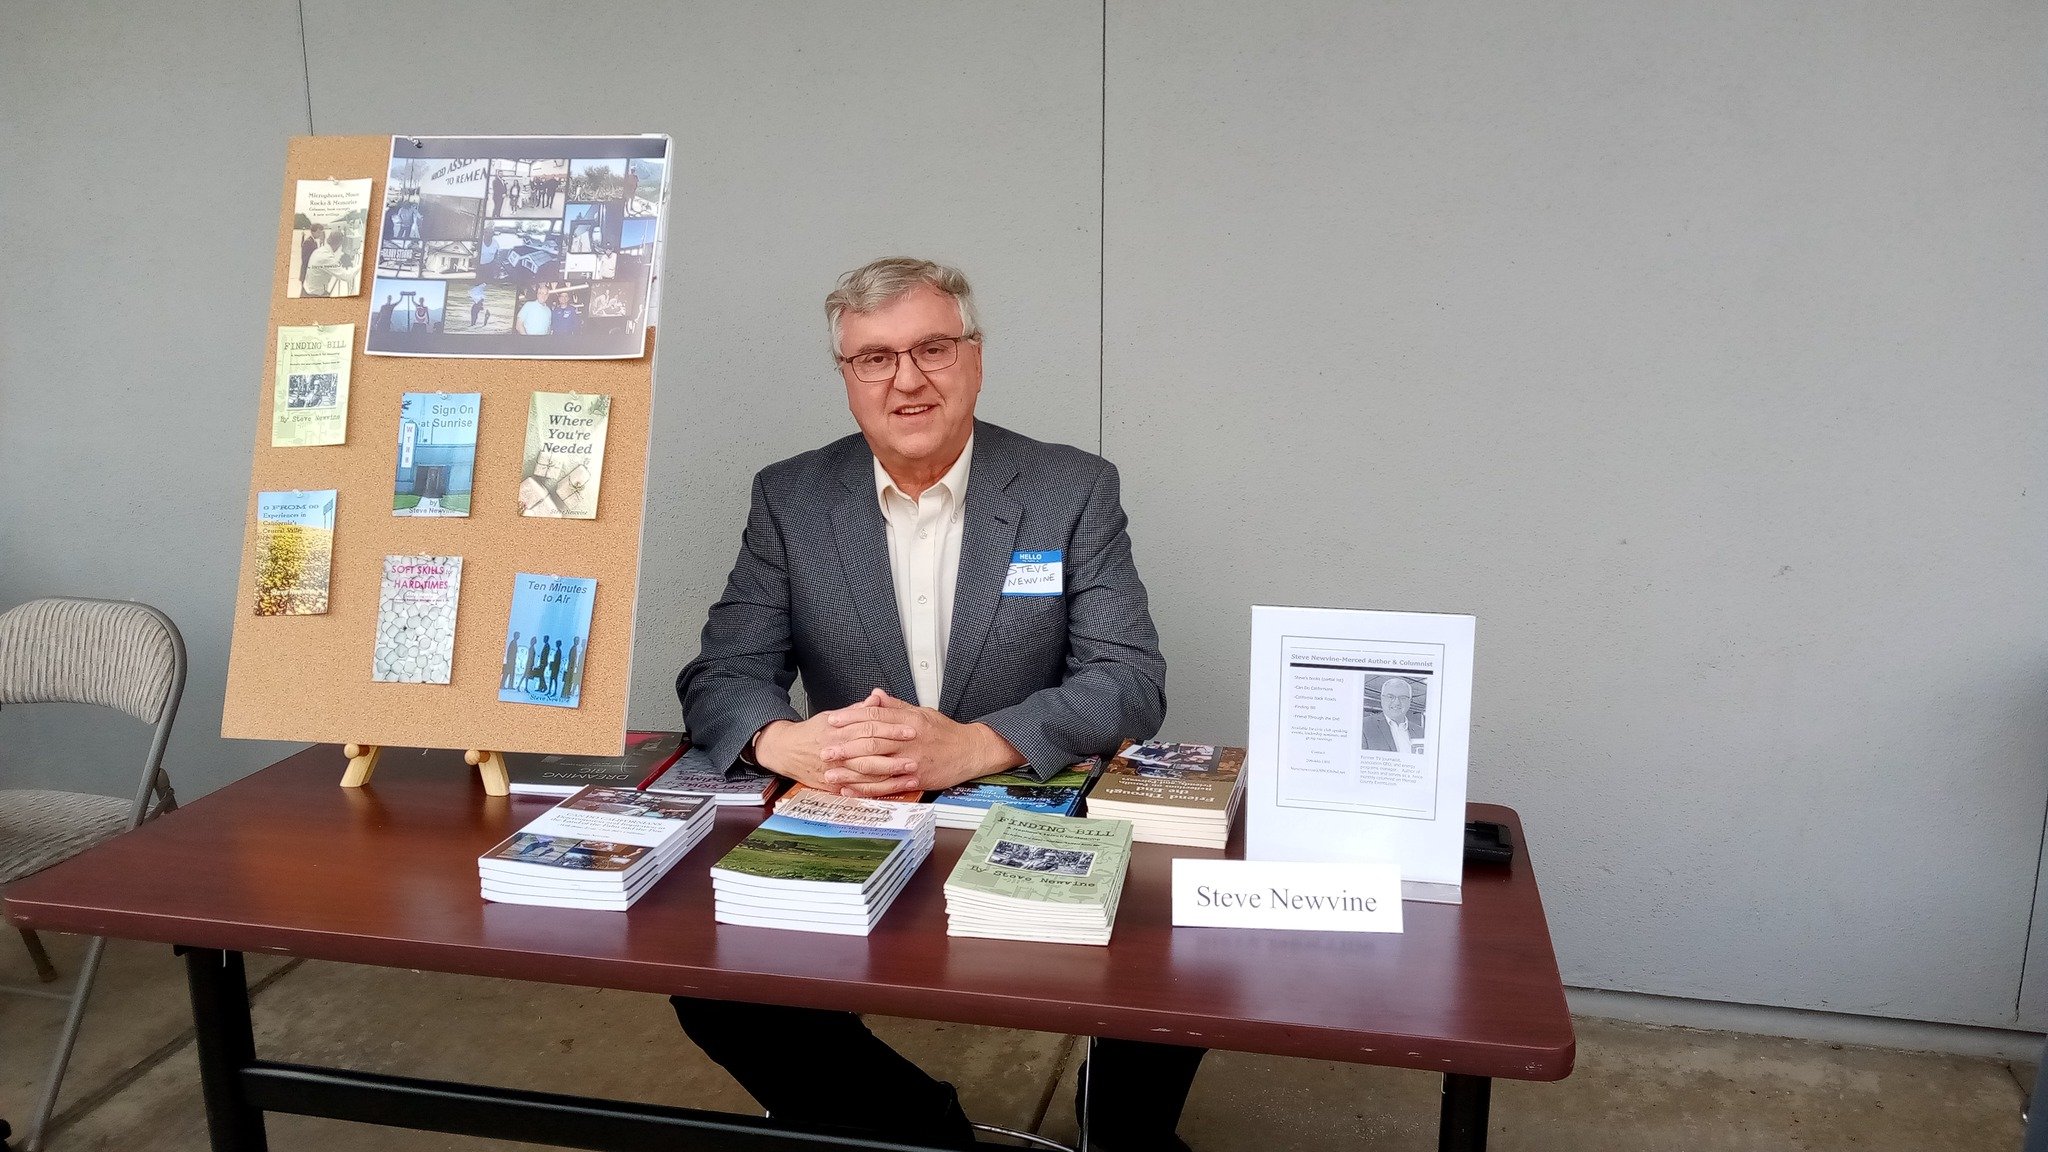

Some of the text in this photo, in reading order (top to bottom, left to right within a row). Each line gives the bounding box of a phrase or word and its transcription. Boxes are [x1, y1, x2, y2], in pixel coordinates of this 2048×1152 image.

[284, 340, 347, 350] FINDING BILL
[432, 404, 474, 417] Sign On
[563, 401, 582, 413] Go
[420, 418, 473, 428] at Sunrise
[549, 414, 594, 427] Where
[548, 428, 591, 440] You're
[540, 442, 593, 454] Needed
[429, 500, 438, 508] by
[391, 565, 414, 574] SOFT
[417, 565, 444, 575] SKILLS
[1007, 564, 1049, 576] STEVE
[394, 580, 448, 590] HARD TIMES
[1008, 573, 1055, 586] NEWVINE
[528, 581, 588, 594] Ten Minutes
[543, 594, 571, 604] to Air
[1368, 658, 1390, 666] Author
[1399, 660, 1433, 668] Columnist
[542, 771, 629, 780] DREAMING
[1105, 788, 1164, 799] Through
[799, 799, 890, 814] CALIFORNIA
[791, 806, 893, 823] BACK ROADS
[998, 816, 1115, 837] FINDING BILL
[970, 865, 1096, 888] By Steve Newvine
[1197, 886, 1378, 912] Steve Newvine
